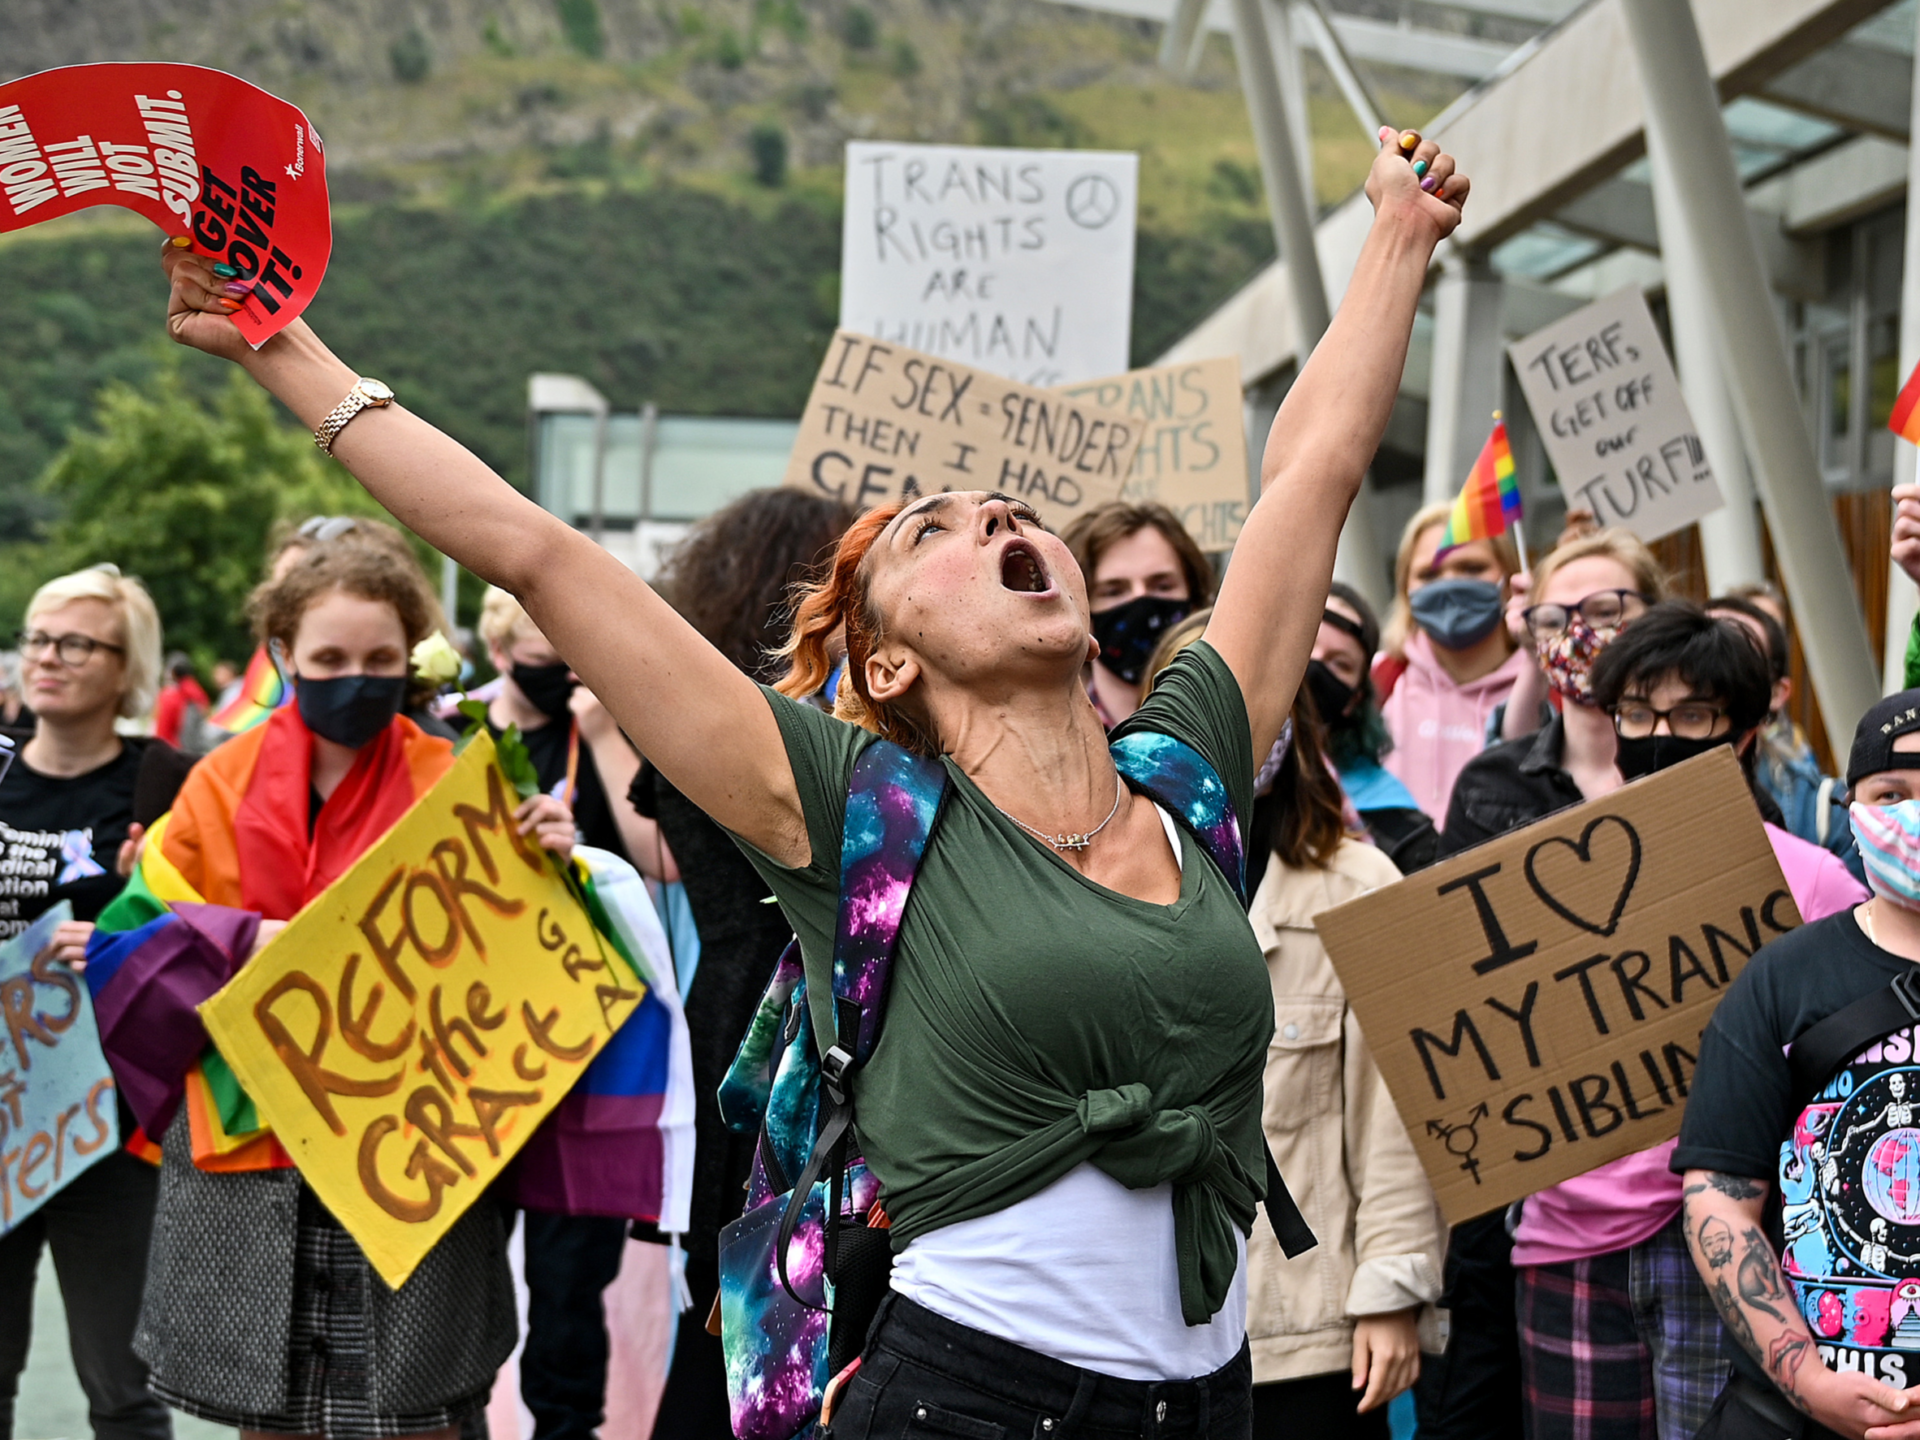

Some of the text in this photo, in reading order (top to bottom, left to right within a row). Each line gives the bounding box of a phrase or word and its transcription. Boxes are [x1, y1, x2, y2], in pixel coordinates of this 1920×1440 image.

[43, 134, 111, 198] WILL
[98, 141, 161, 201] NOT
[134, 89, 200, 228] SUBMIT.
[860, 153, 1045, 205] TRANS
[193, 165, 238, 253] GET
[228, 165, 276, 282] OVER
[873, 206, 1046, 263] RIGHTS
[250, 246, 303, 316] IT!
[922, 269, 996, 301] ARE
[823, 336, 891, 395] IF
[891, 358, 974, 427] SEX
[1550, 374, 1653, 438] GET OFF
[821, 404, 1083, 507] THEN I HAD
[1130, 421, 1221, 476] HTS
[253, 763, 545, 1137] REFORM
[1437, 862, 1538, 977] I
[0, 943, 81, 1071] RS
[416, 980, 508, 1099] the
[1409, 981, 1541, 1101] MY
[1502, 1030, 1704, 1162] SIBLIN
